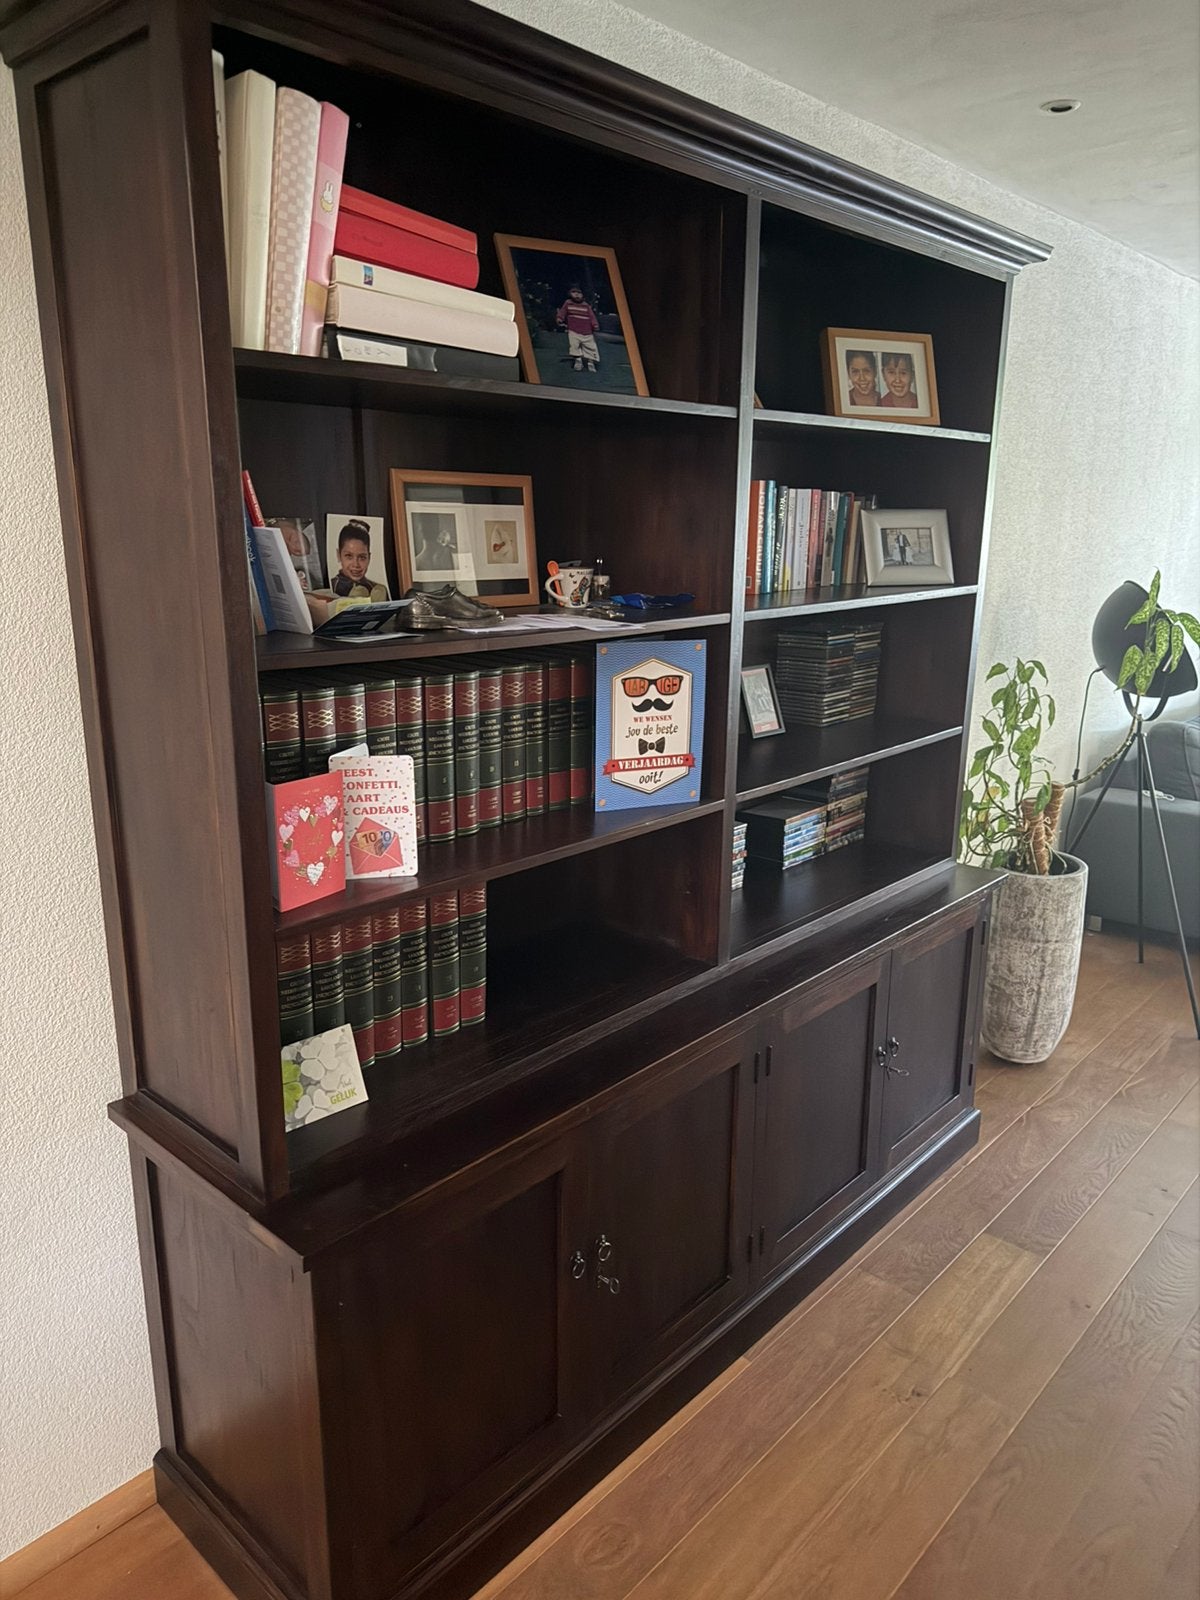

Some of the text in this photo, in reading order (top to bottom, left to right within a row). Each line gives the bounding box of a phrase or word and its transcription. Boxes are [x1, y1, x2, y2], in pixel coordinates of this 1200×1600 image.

[643, 725, 653, 735] de
[656, 724, 678, 734] beste
[618, 756, 684, 770] VERJAARDAG
[639, 771, 663, 784] ooit!
[352, 805, 409, 815] CADEAUS
[362, 832, 377, 843] 10
[330, 1088, 357, 1104] GELUK
